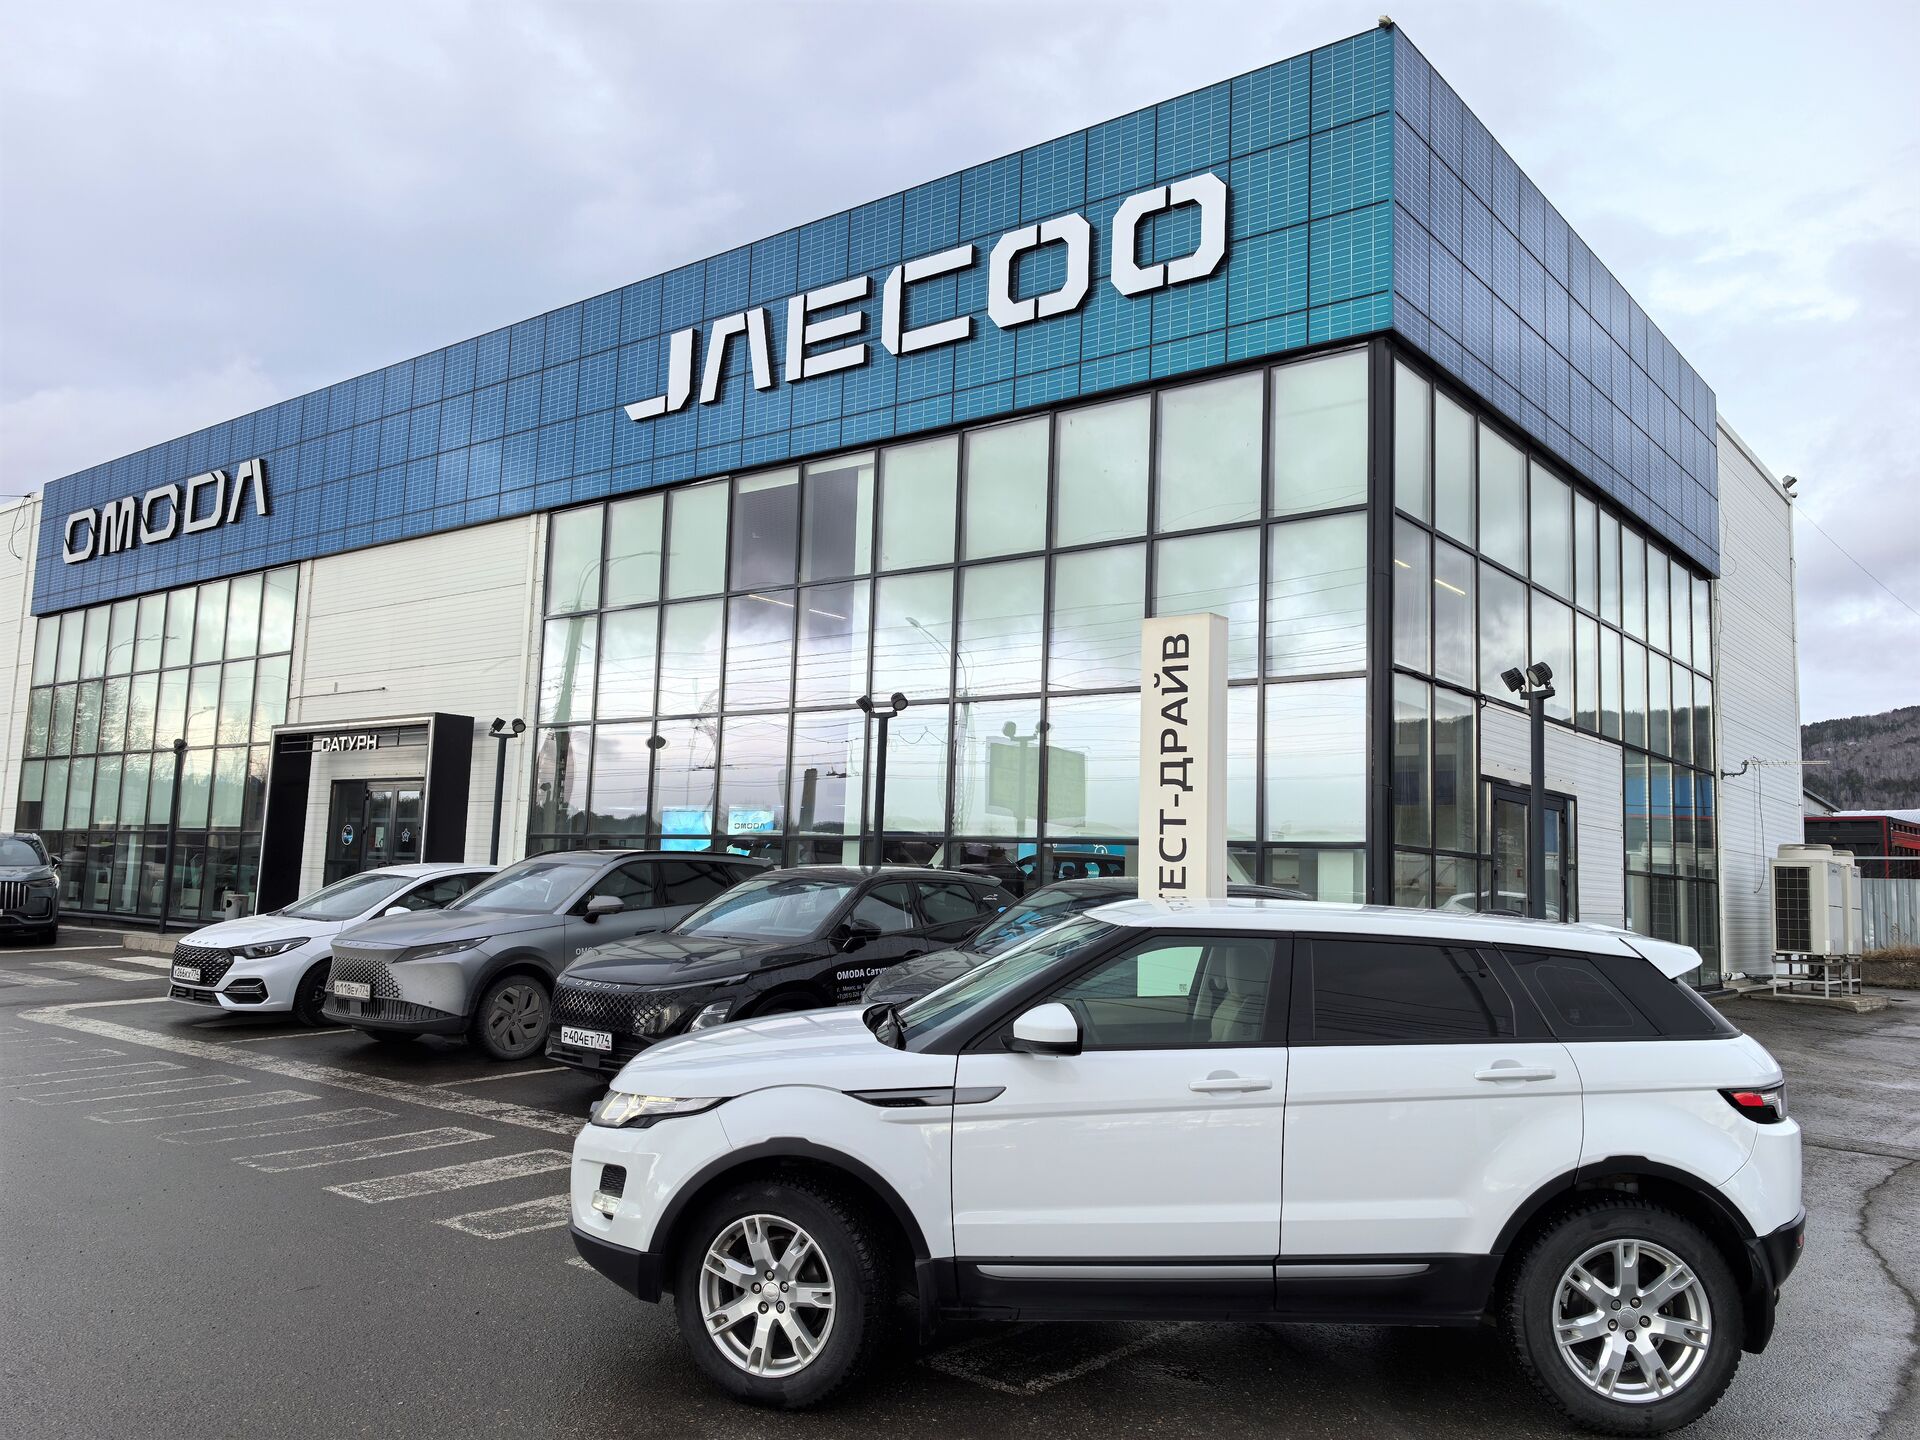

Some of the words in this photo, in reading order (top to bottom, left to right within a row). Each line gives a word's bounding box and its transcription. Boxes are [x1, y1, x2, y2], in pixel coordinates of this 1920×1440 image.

[623, 172, 1228, 422] JAECOO
[62, 458, 267, 564] OMODA
[320, 734, 378, 752] САТУРН
[733, 822, 766, 830] OMODA
[836, 968, 865, 980] OMODA
[575, 980, 621, 990] OMODA
